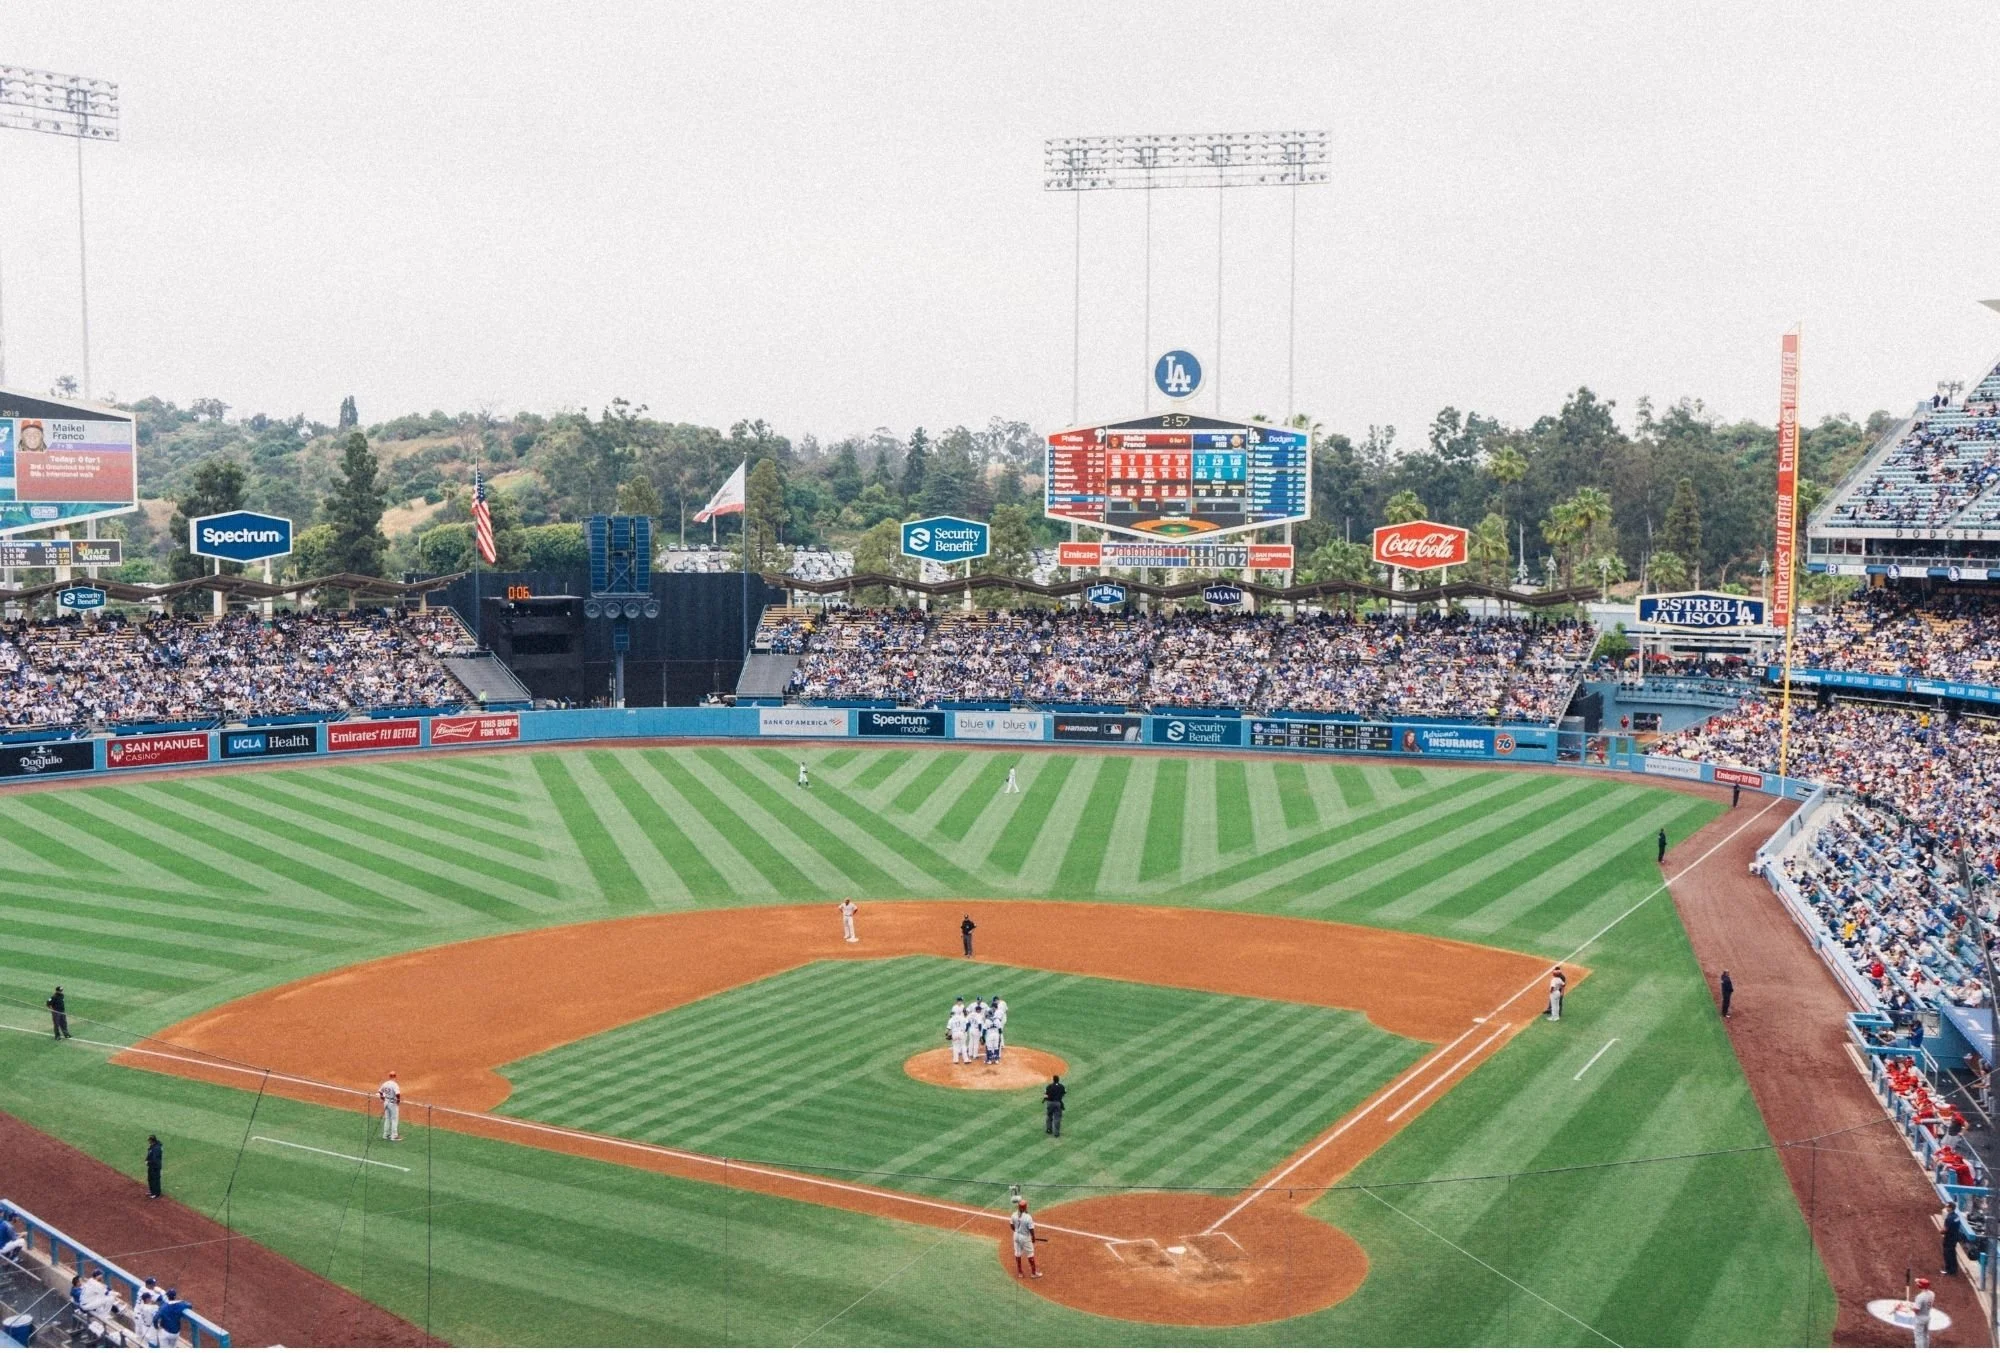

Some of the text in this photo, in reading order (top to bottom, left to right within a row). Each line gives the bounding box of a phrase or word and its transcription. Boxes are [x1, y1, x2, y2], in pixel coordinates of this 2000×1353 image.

[1166, 356, 1191, 392] LA
[1162, 416, 1190, 427] 2:57
[53, 424, 85, 432] Maikel
[1248, 428, 1260, 444] LA
[1269, 436, 1296, 444] Dodgers
[1780, 408, 1794, 472] Emirates
[203, 528, 280, 546] Spectrum
[934, 528, 980, 542] Security
[1896, 528, 1984, 539] DODGER
[934, 540, 974, 552] Benefit
[1381, 532, 1458, 558] Coca-Cola
[1063, 550, 1098, 558] Emirates
[1218, 553, 1246, 566] 0 0 2
[1774, 494, 1792, 614] Emirates FLY BETTER
[76, 592, 102, 600] Security
[1090, 588, 1102, 600] JIM
[1102, 586, 1123, 600] BEAM
[1206, 591, 1240, 600] DASANI
[1656, 598, 1736, 612] ESTREL
[1648, 611, 1730, 626] JALISCO
[1752, 667, 1766, 676] 2:57
[480, 718, 518, 728] THIS BUD'S
[872, 713, 927, 727] Spectrum
[960, 718, 1026, 730] blue blue
[480, 727, 512, 736] FOR YOU.
[900, 726, 928, 734] mobile
[1188, 722, 1227, 734] Security
[331, 727, 418, 744] Emirates FLY BETTER
[1188, 732, 1222, 744] Benefit
[1423, 730, 1459, 740] Adriana's
[126, 738, 204, 754] SAN MANUEL
[234, 734, 309, 750] UCLA Health
[1428, 738, 1484, 749] INSURANCE
[1497, 739, 1512, 749] 76
[126, 752, 158, 762] CASINO
[1717, 771, 1740, 782] Emirates
